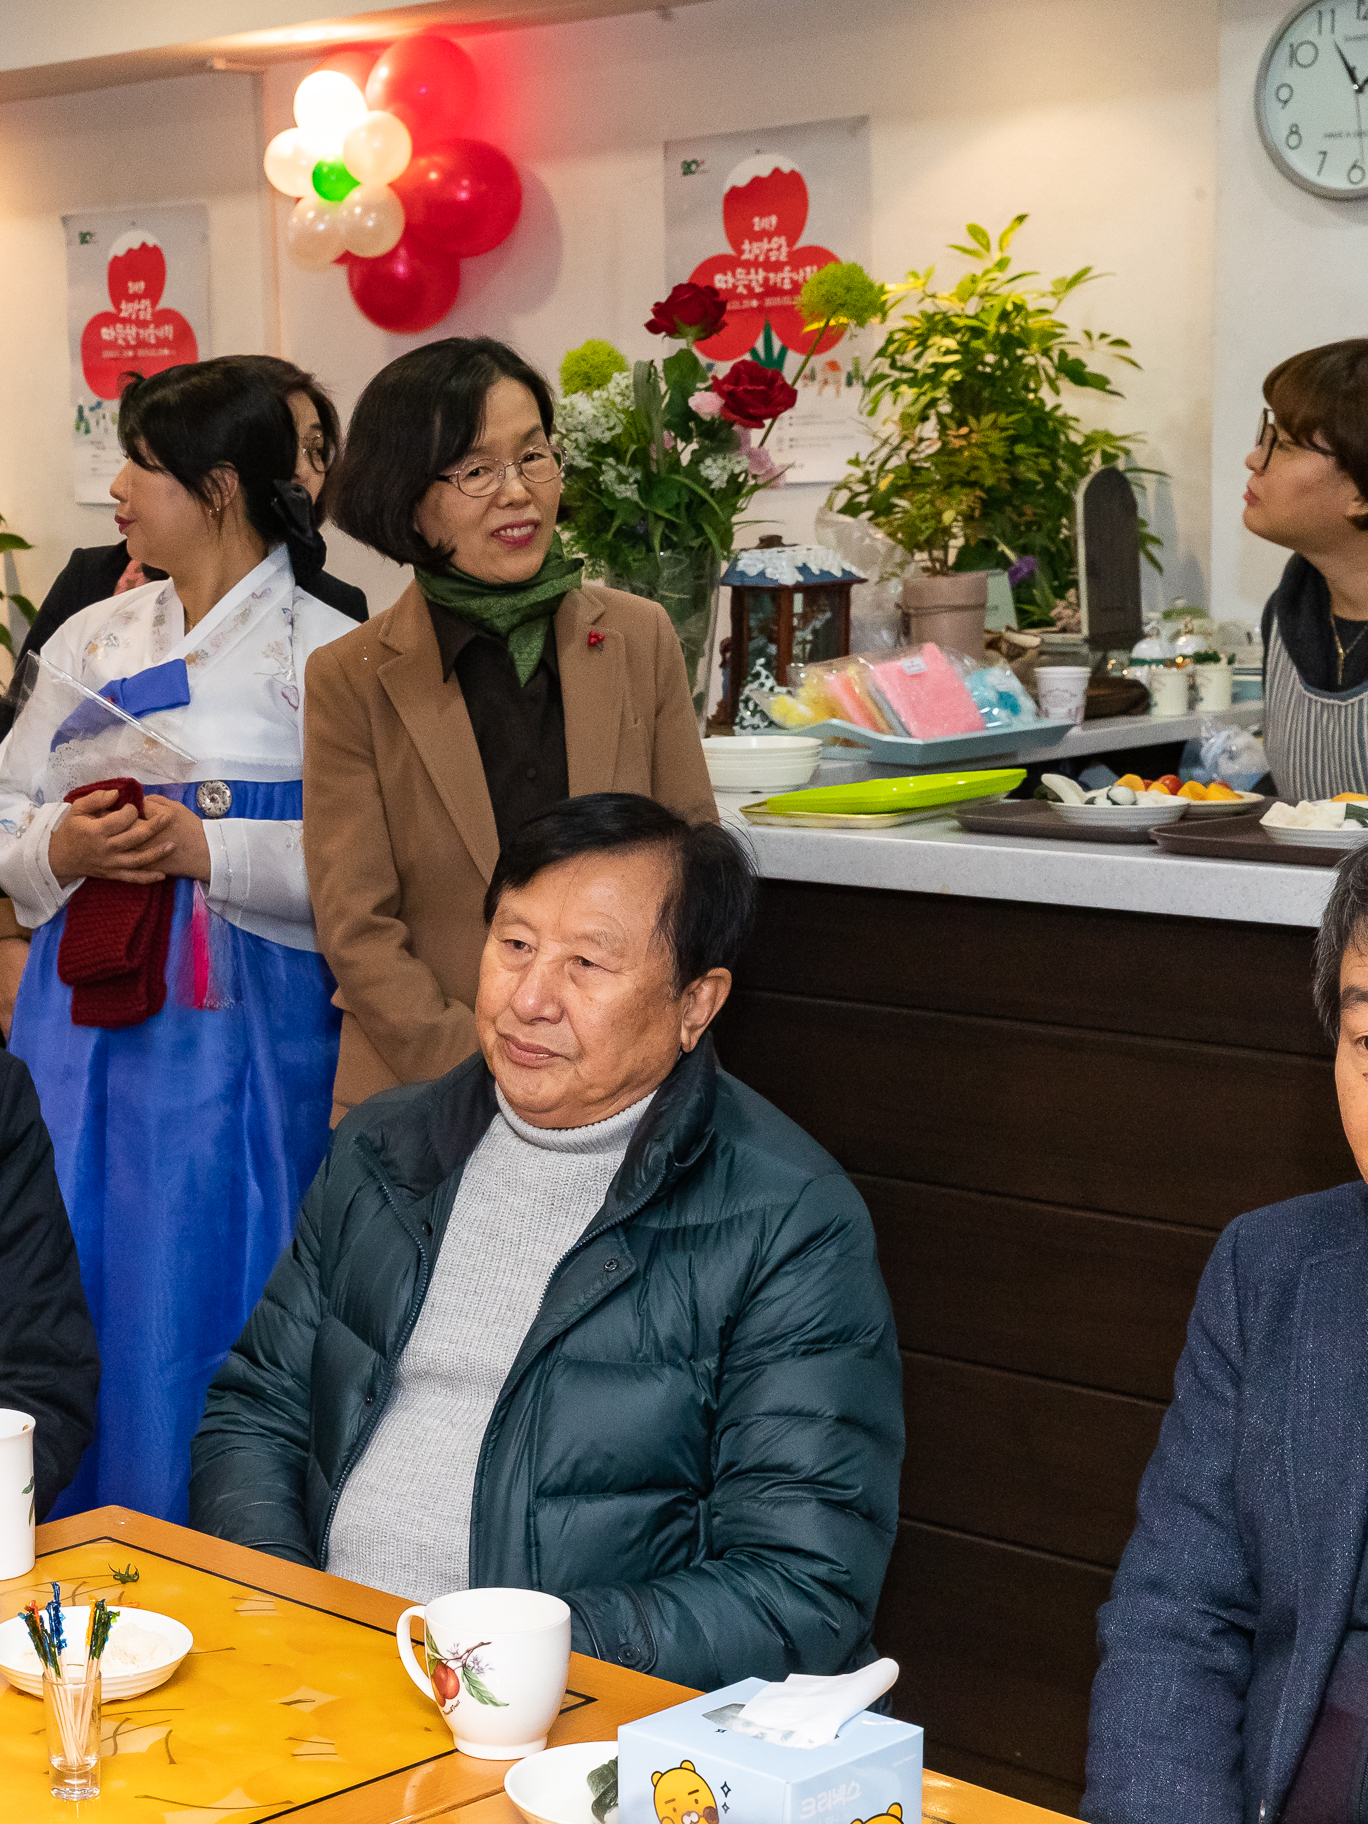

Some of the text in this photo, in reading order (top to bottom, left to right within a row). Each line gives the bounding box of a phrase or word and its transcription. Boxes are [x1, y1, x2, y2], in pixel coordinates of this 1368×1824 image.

[1317, 8, 1335, 36] 11
[1288, 39, 1320, 69] 10
[1275, 82, 1294, 110] 9
[1285, 122, 1303, 151] 8
[1317, 150, 1328, 178] 7
[1347, 159, 1367, 186] 6
[800, 1780, 862, 1821] 크리넥스
